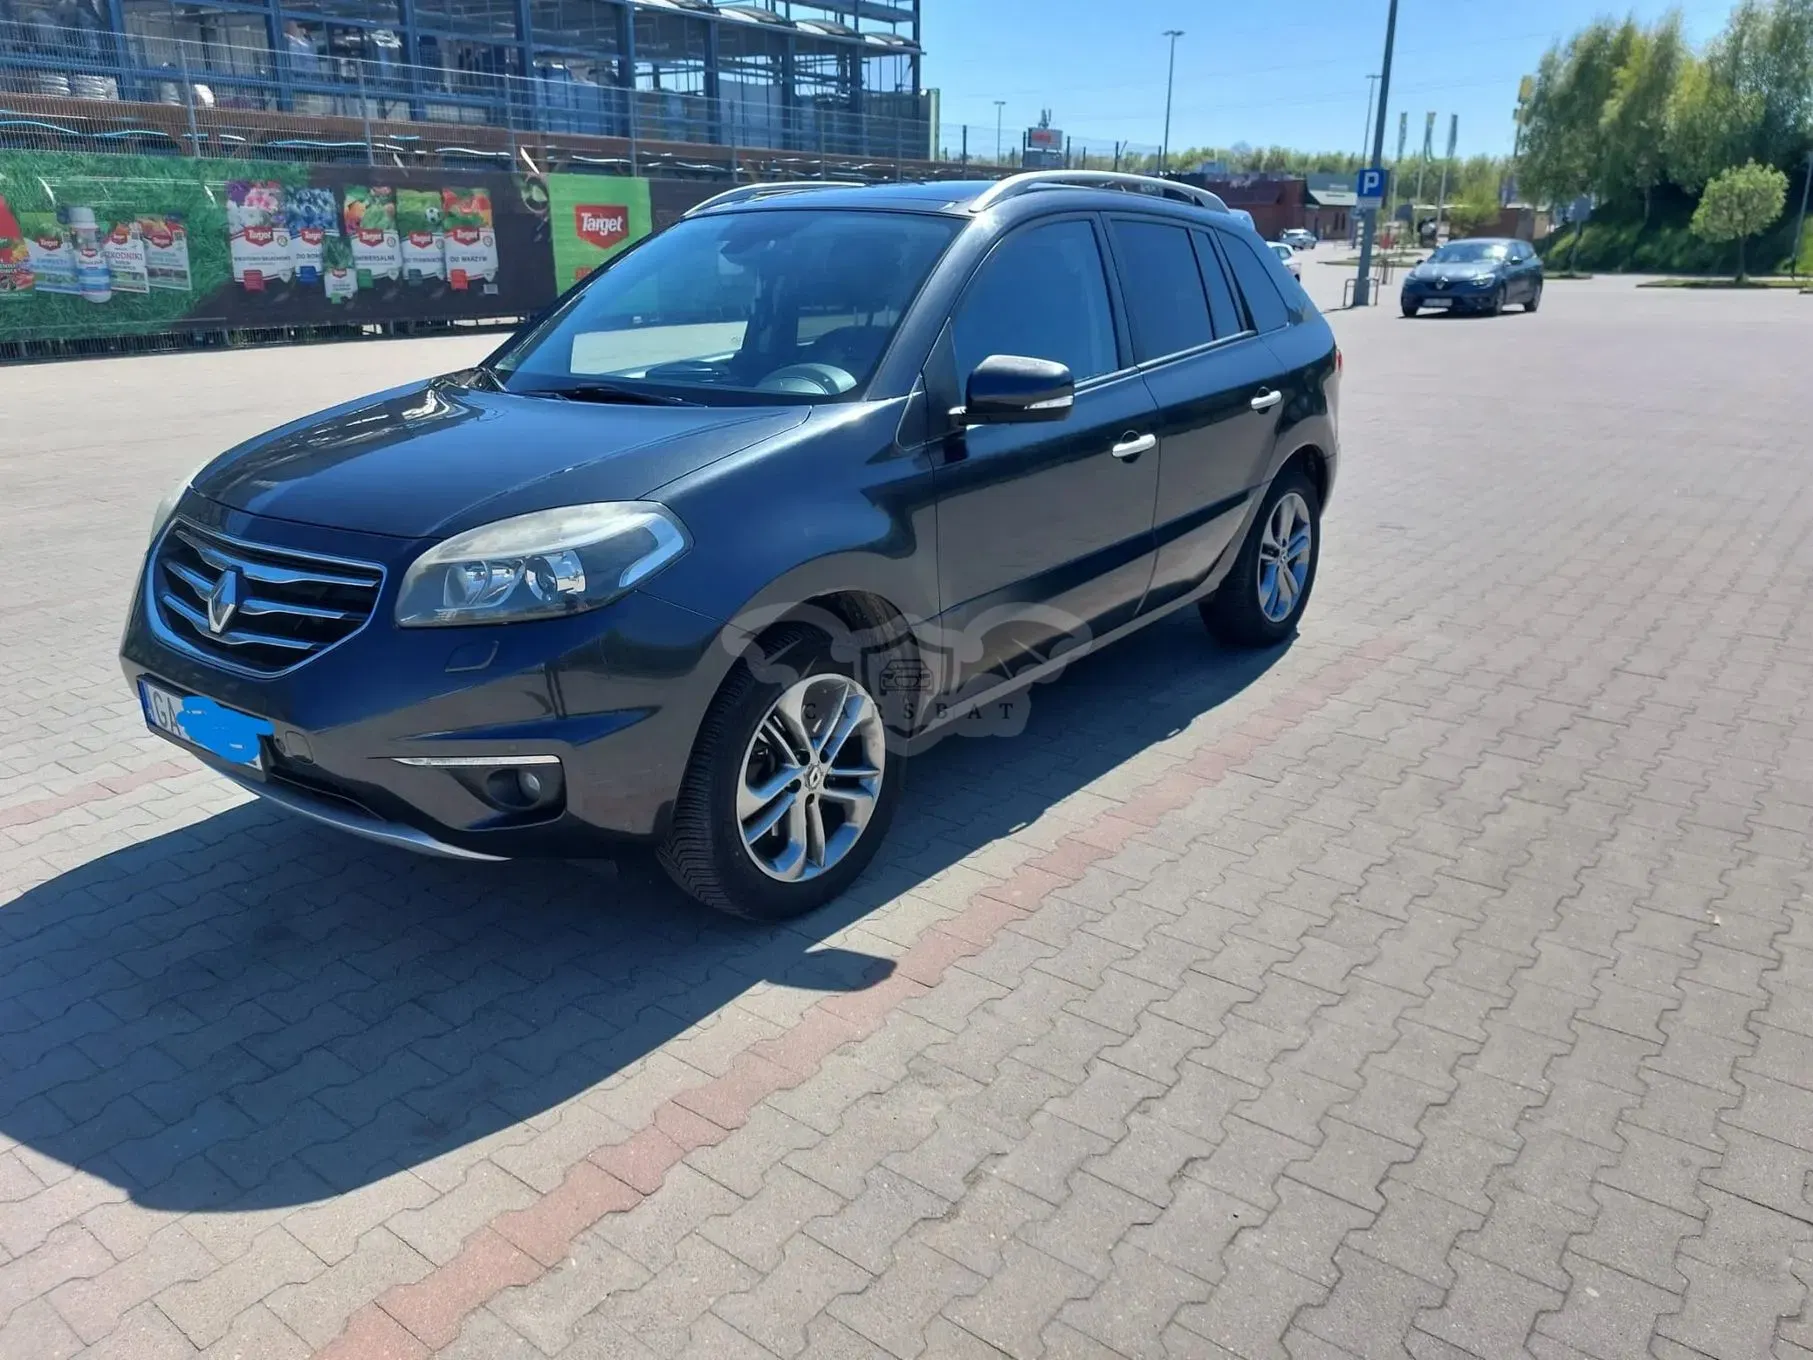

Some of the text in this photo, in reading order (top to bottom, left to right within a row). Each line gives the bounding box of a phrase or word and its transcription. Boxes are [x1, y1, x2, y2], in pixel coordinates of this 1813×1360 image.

[1363, 171, 1380, 194] P
[248, 229, 271, 241] Target
[581, 212, 623, 236] Target
